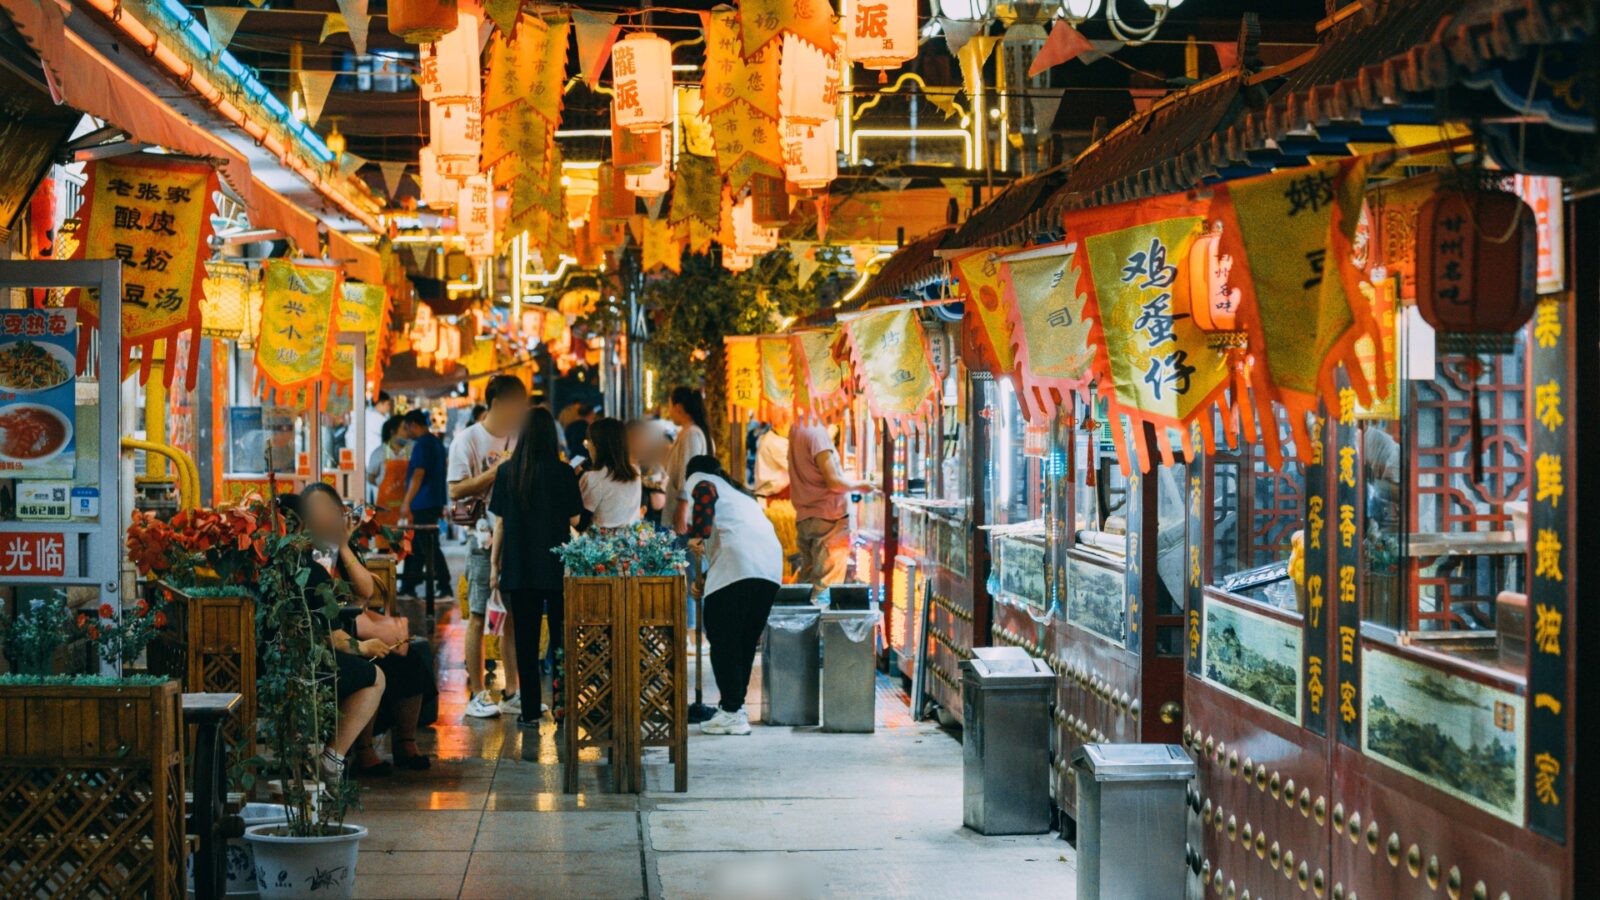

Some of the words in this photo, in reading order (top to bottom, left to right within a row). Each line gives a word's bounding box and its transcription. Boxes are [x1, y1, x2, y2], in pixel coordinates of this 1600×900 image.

[107, 178, 191, 204] 老张家
[114, 205, 177, 236] 酿皮
[113, 243, 174, 272] 豆粉
[87, 282, 184, 312] 豆汤
[0, 314, 67, 336] 季热卖
[1121, 237, 1196, 401] 鸡蛋仔
[0, 536, 63, 572] 光临
